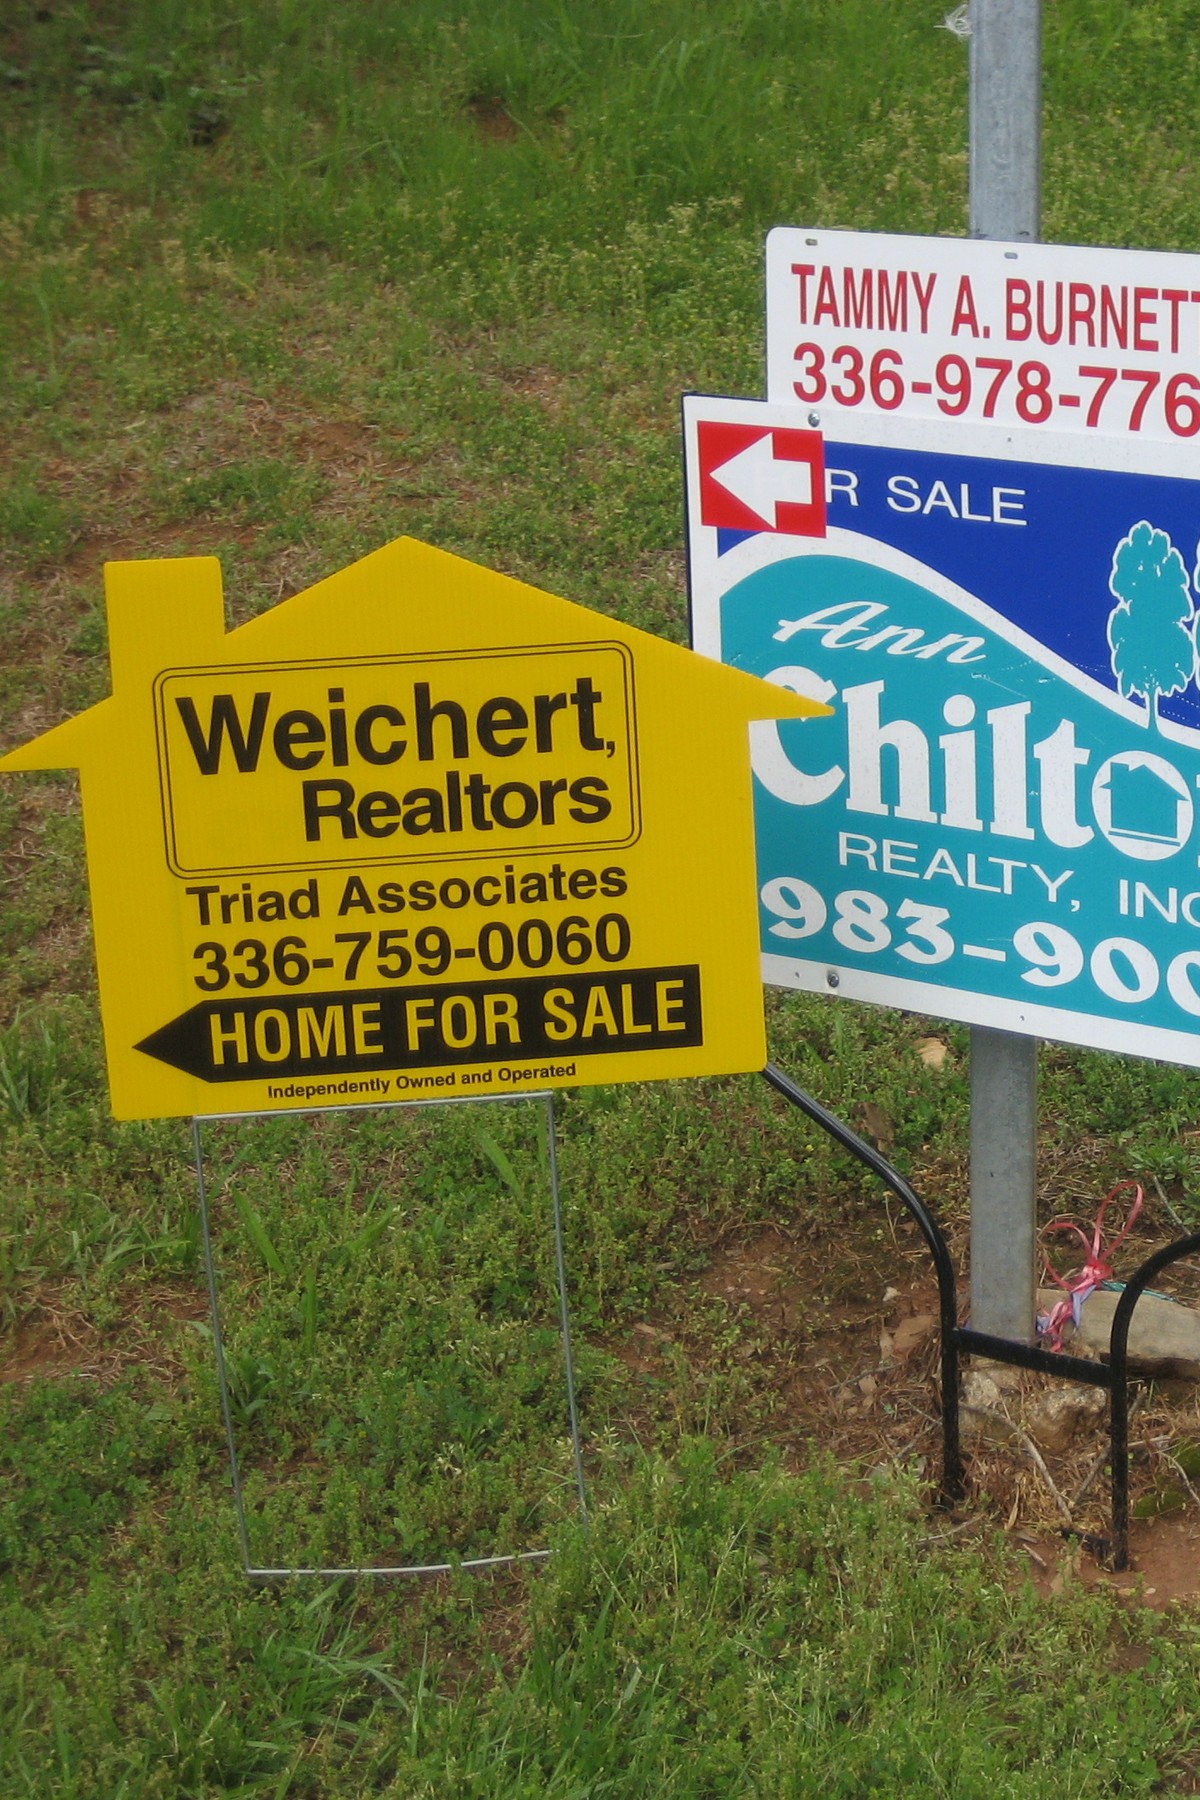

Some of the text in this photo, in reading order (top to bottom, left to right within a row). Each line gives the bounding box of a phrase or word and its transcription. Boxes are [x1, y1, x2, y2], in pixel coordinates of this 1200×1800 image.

[792, 263, 937, 335] TAMMY
[951, 274, 990, 339] A.
[887, 476, 1027, 526] SALE
[772, 601, 987, 663] Ann
[175, 677, 616, 776] Weichert,
[303, 771, 612, 842] Realtors
[186, 864, 627, 926] Triad Associates
[839, 831, 1081, 913] REALTY,
[193, 913, 631, 991] 336-759-0060
[210, 979, 685, 1065] HOME FOR SALE
[268, 1064, 576, 1099] Independently Owned and Operated
